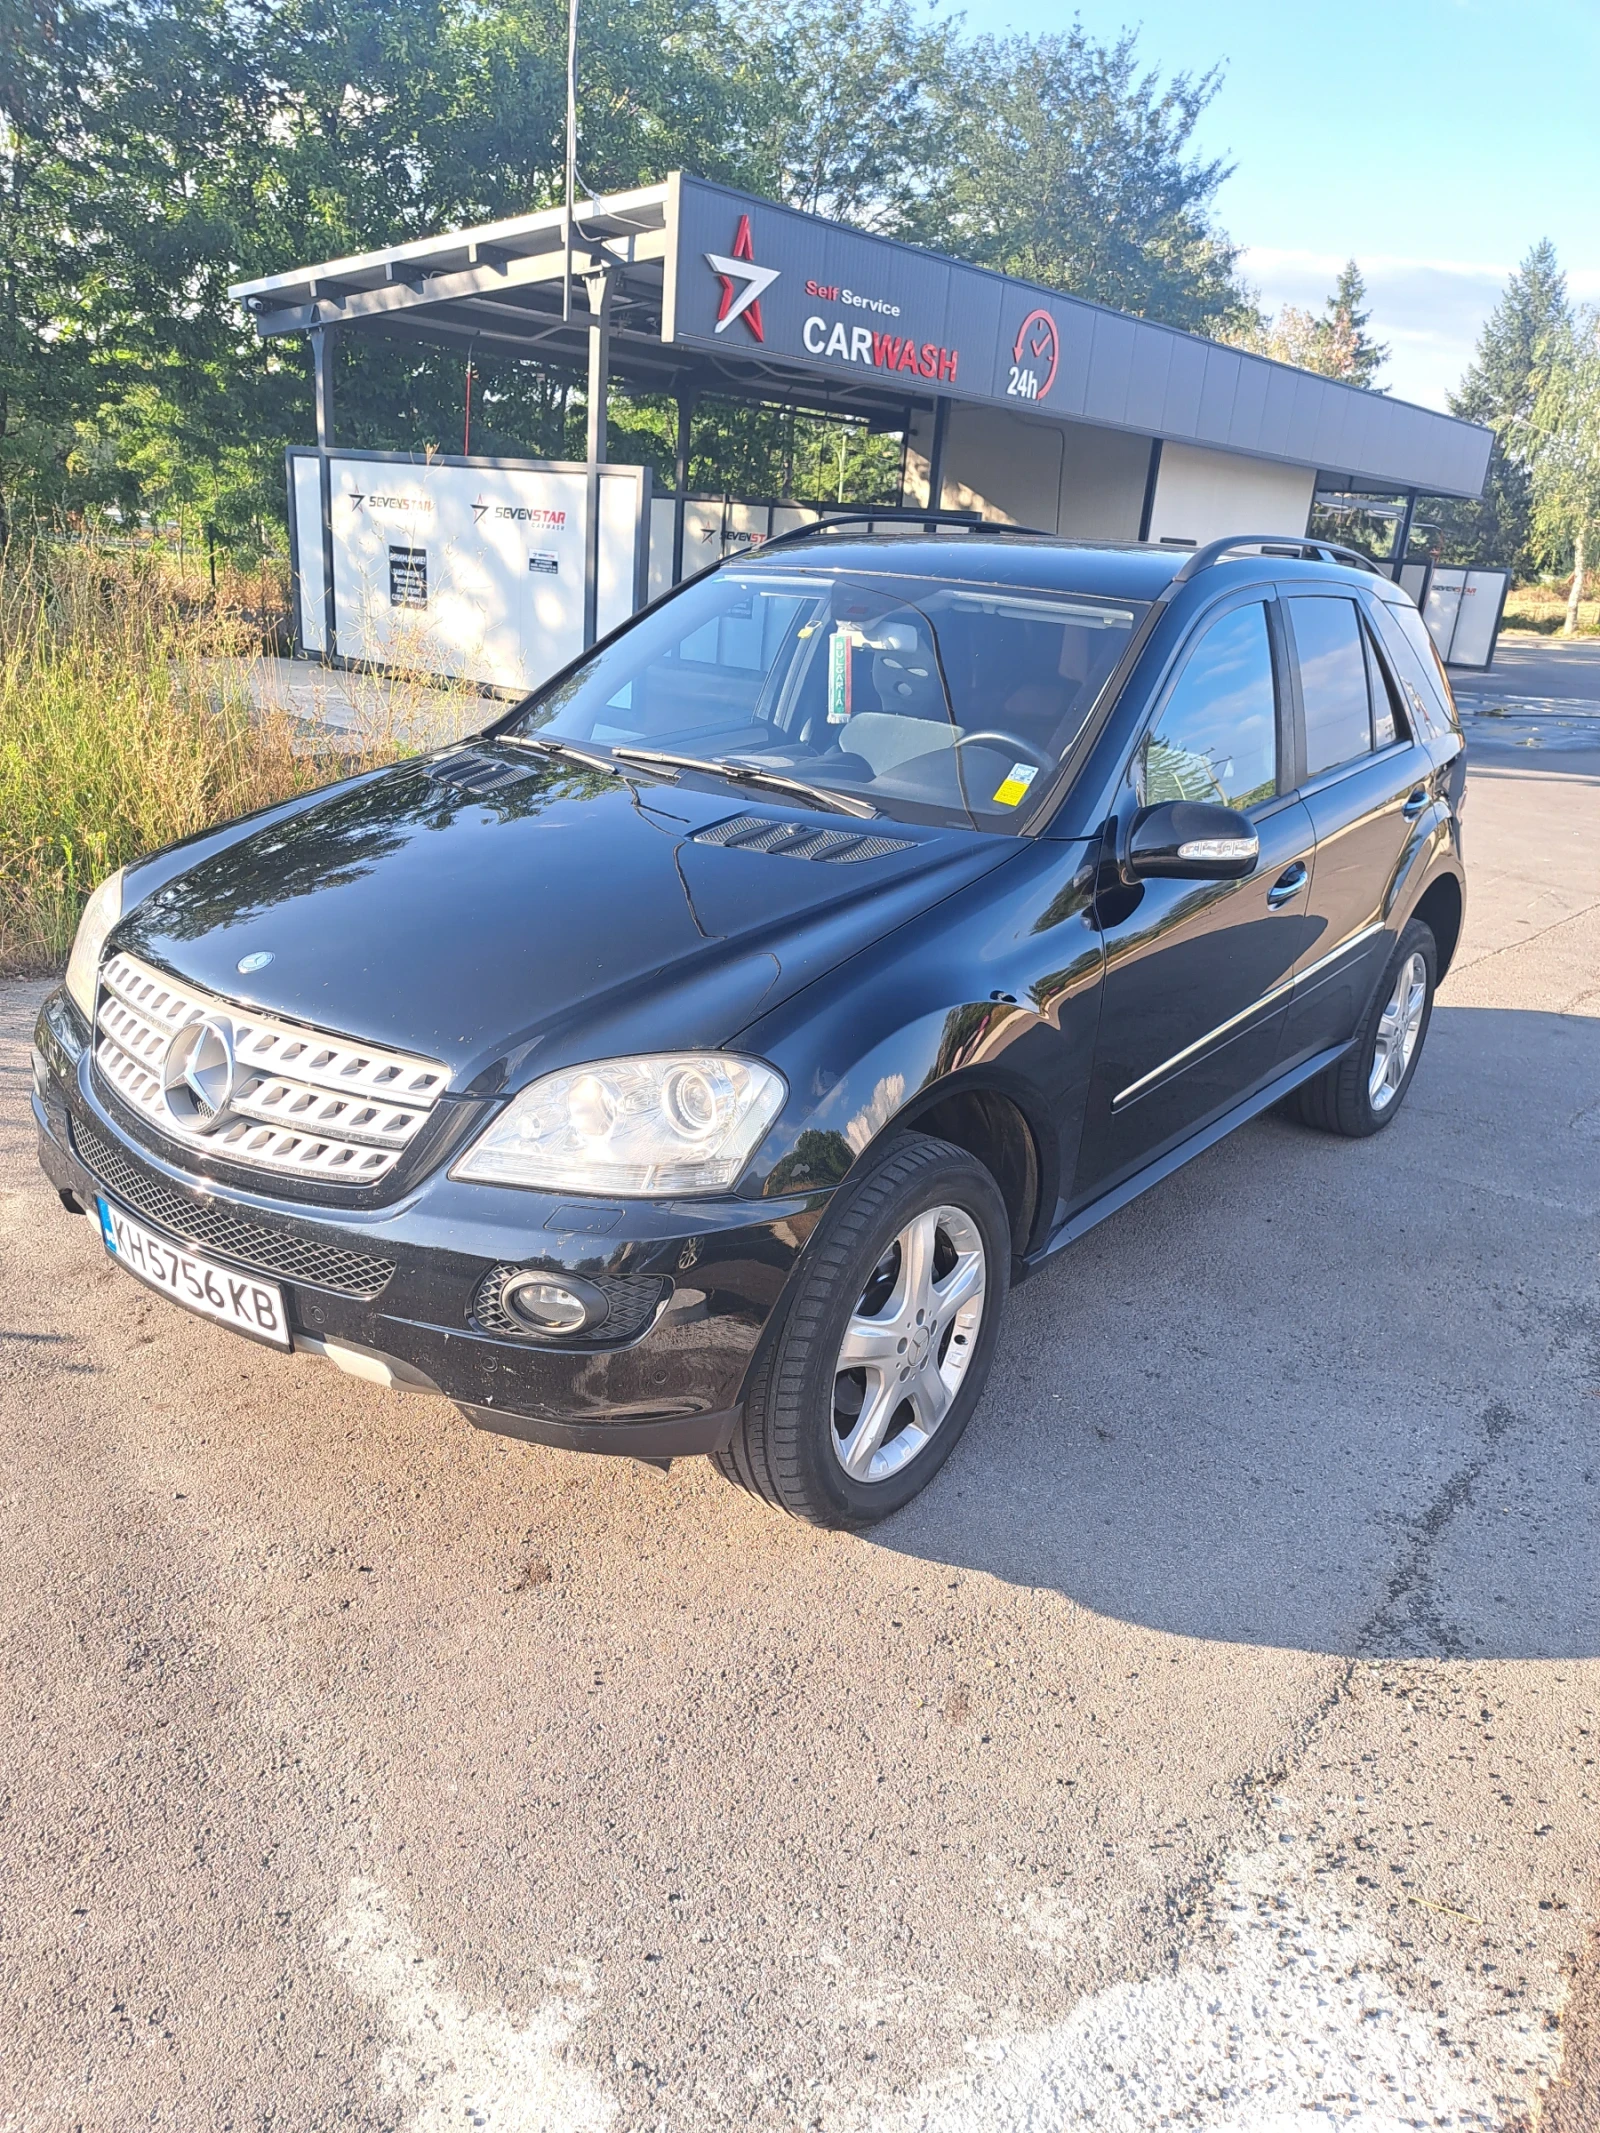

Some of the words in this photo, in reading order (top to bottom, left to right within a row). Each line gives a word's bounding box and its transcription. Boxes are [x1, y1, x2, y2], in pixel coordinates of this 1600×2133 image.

[805, 280, 839, 301] Self
[841, 289, 900, 317] Service
[802, 316, 958, 382] CARWASH
[1006, 366, 1038, 400] 24h
[494, 506, 566, 524] SEVENSTAR
[835, 641, 844, 707] BULGARIA
